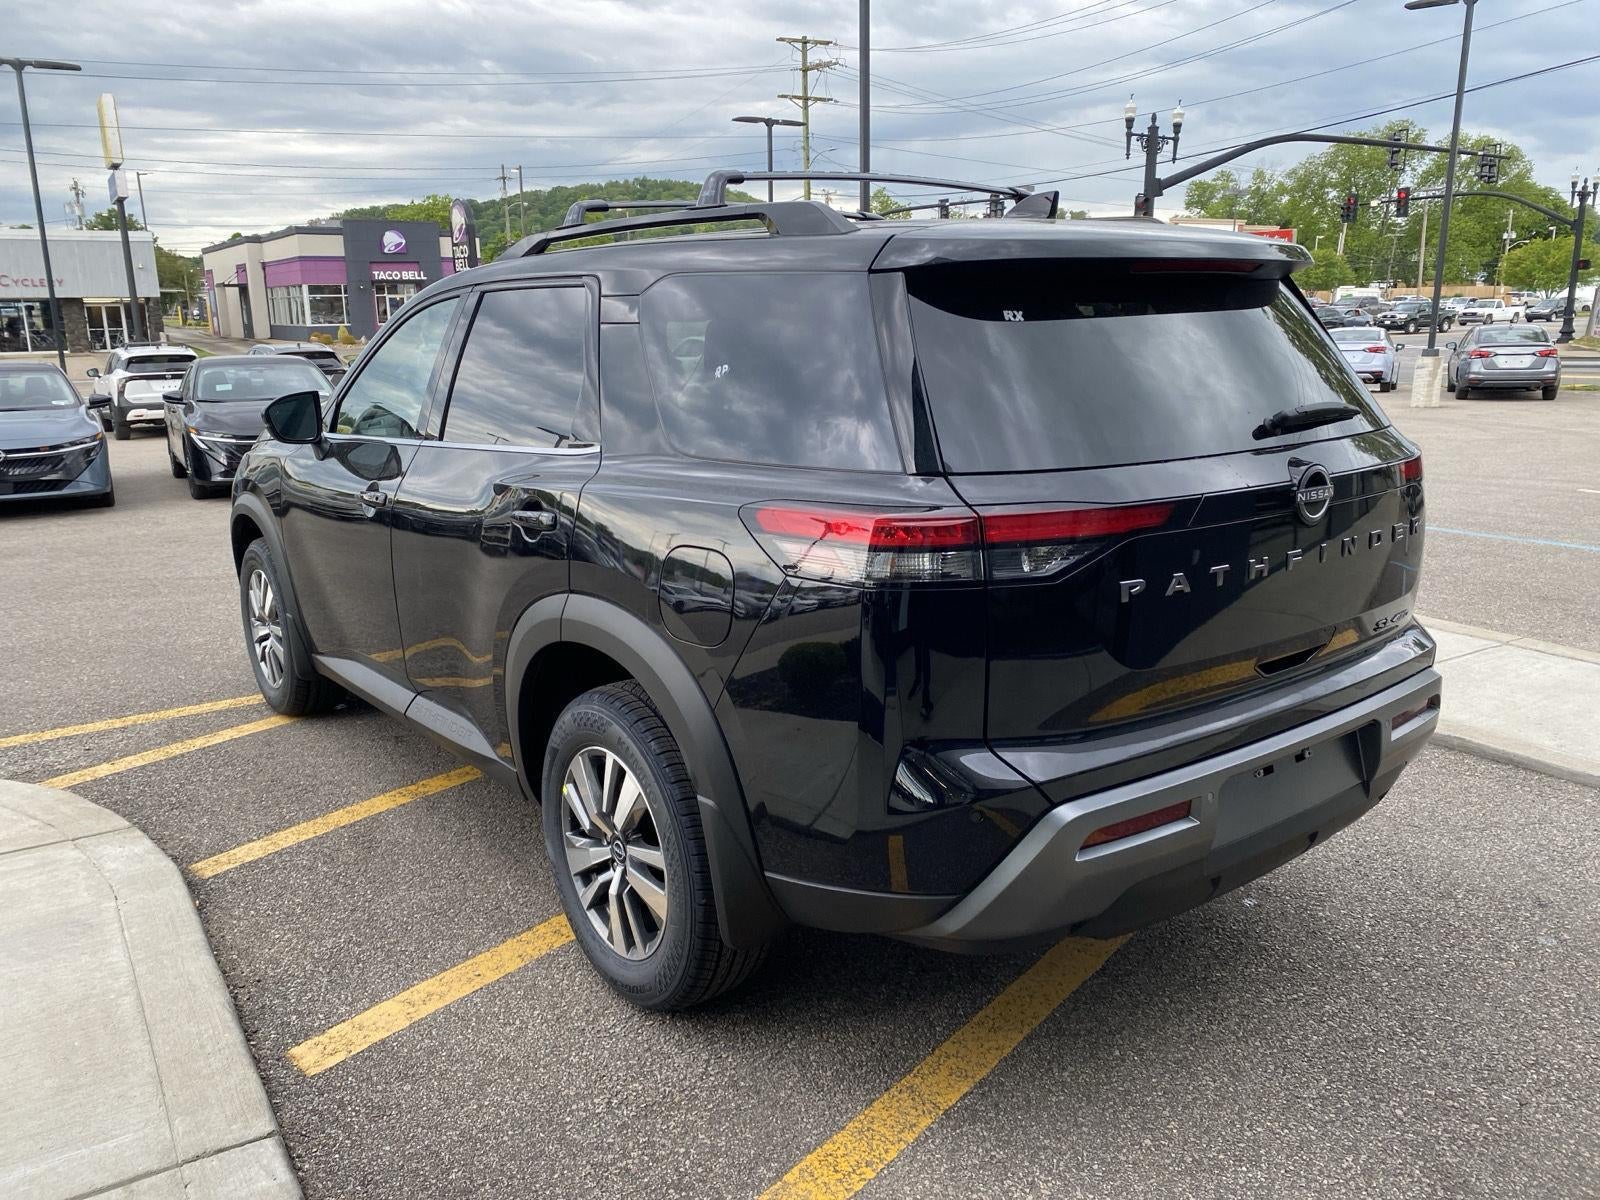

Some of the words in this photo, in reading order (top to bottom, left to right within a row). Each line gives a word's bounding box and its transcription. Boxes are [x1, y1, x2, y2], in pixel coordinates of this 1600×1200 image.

[453, 245, 469, 258] TACO
[455, 258, 469, 272] BELL
[0, 274, 64, 288] CYCLEY
[372, 271, 401, 280] TACO
[402, 271, 427, 280] BELL
[1003, 310, 1024, 321] RX
[1297, 487, 1334, 502] NISSAN
[1119, 516, 1420, 603] PATHFINDER
